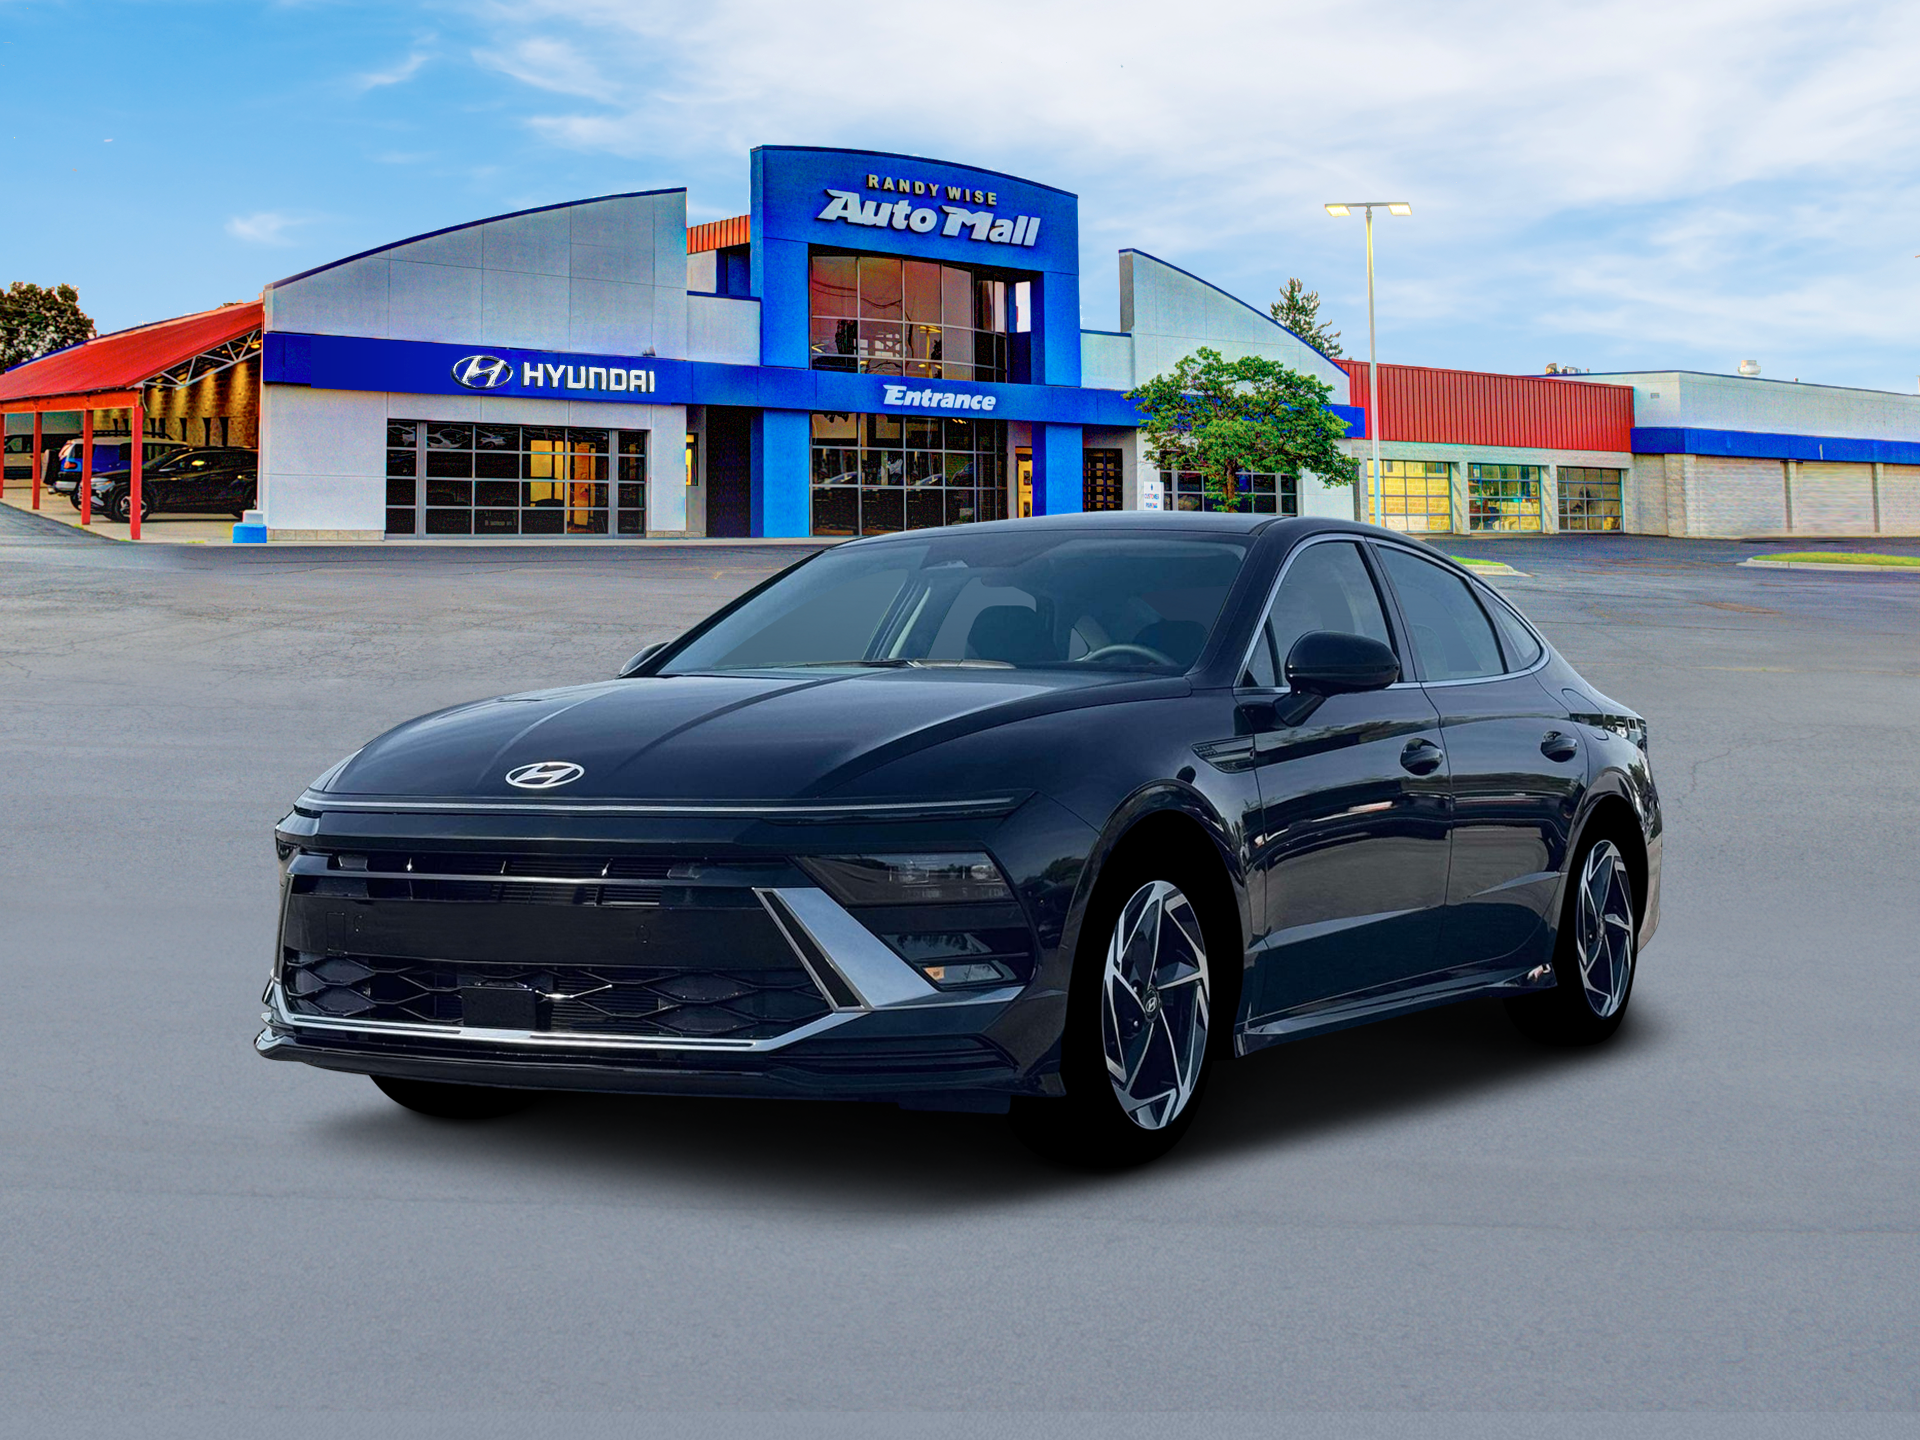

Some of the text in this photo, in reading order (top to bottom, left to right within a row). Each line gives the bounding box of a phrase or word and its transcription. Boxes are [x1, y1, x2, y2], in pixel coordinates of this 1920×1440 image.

[866, 173, 998, 206] RANDY WISE
[816, 188, 1042, 247] Auto Mall
[521, 361, 656, 393] HYUNDAI
[882, 384, 997, 411] Entrance
